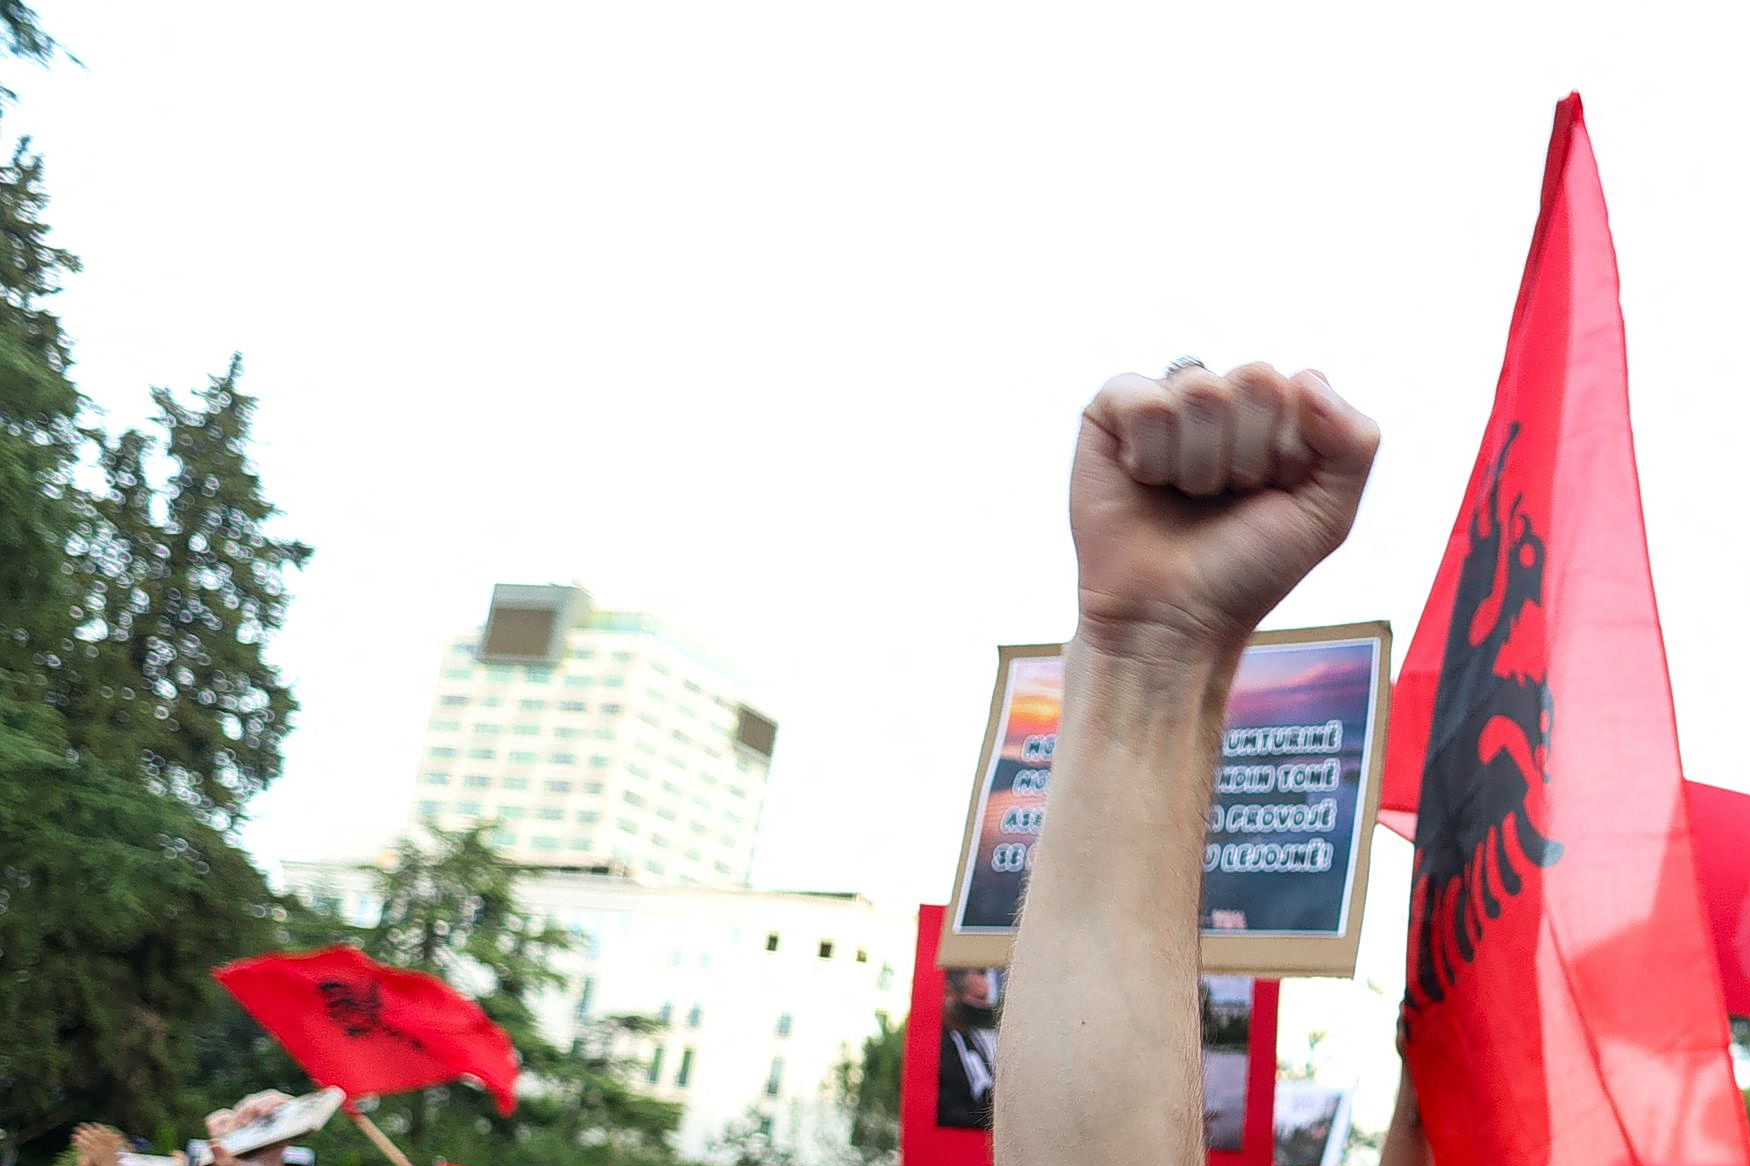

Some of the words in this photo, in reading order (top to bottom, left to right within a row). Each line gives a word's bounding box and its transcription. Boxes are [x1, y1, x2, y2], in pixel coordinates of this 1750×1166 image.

[1226, 722, 1340, 752] UMTURINË
[1217, 768, 1272, 790] NDIN
[1280, 761, 1338, 789] TONË
[1229, 801, 1334, 829] PROVOJË
